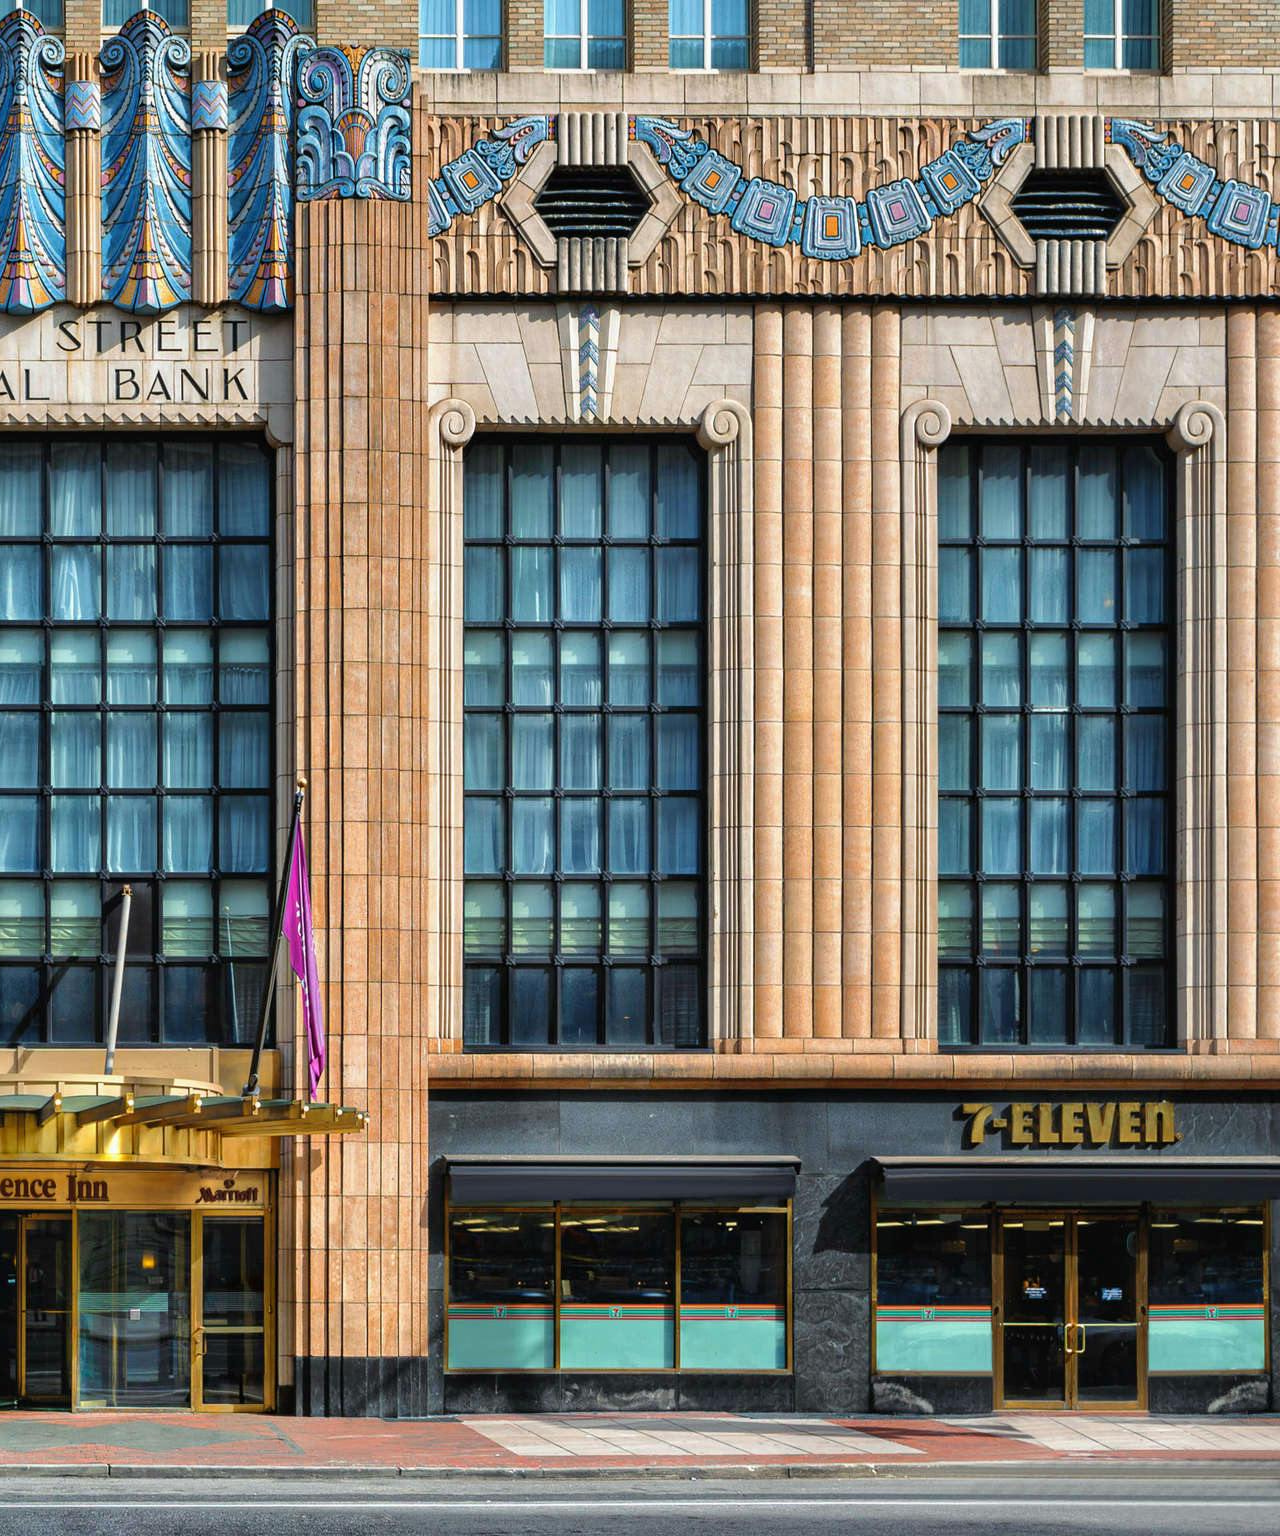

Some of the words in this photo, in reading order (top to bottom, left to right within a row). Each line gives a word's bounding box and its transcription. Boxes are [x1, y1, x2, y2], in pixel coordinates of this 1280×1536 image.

[56, 319, 248, 353] STREET
[114, 368, 250, 402] BANK
[66, 1174, 110, 1202] Inn
